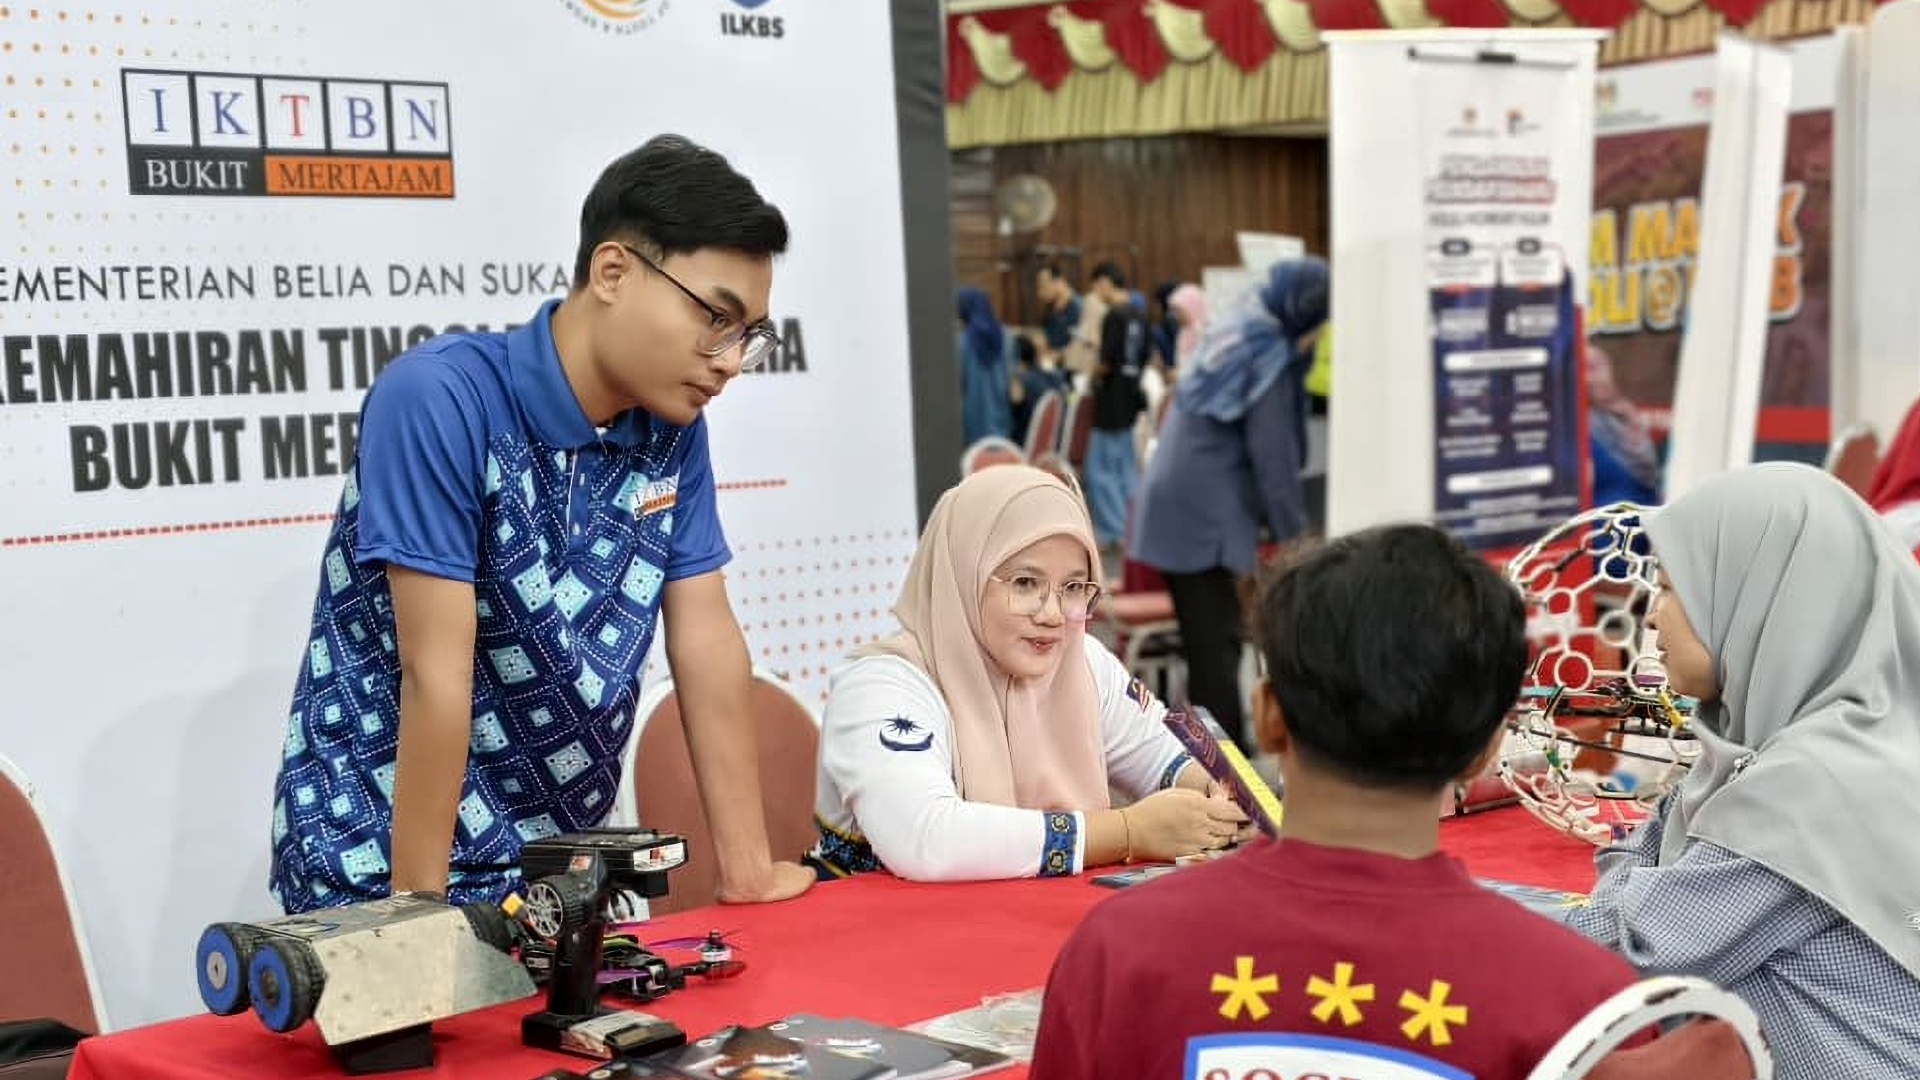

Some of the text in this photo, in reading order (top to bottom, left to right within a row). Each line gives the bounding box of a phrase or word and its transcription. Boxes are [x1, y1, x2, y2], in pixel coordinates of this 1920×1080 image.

[719, 13, 785, 38] ILKBS
[145, 158, 442, 192] BUKIT MERTAJAM
[0, 261, 574, 302] MENTERIAN BELIA DAN SUKA
[0, 328, 308, 405] EMAHIRAN
[69, 411, 360, 493] BUKIT MER
